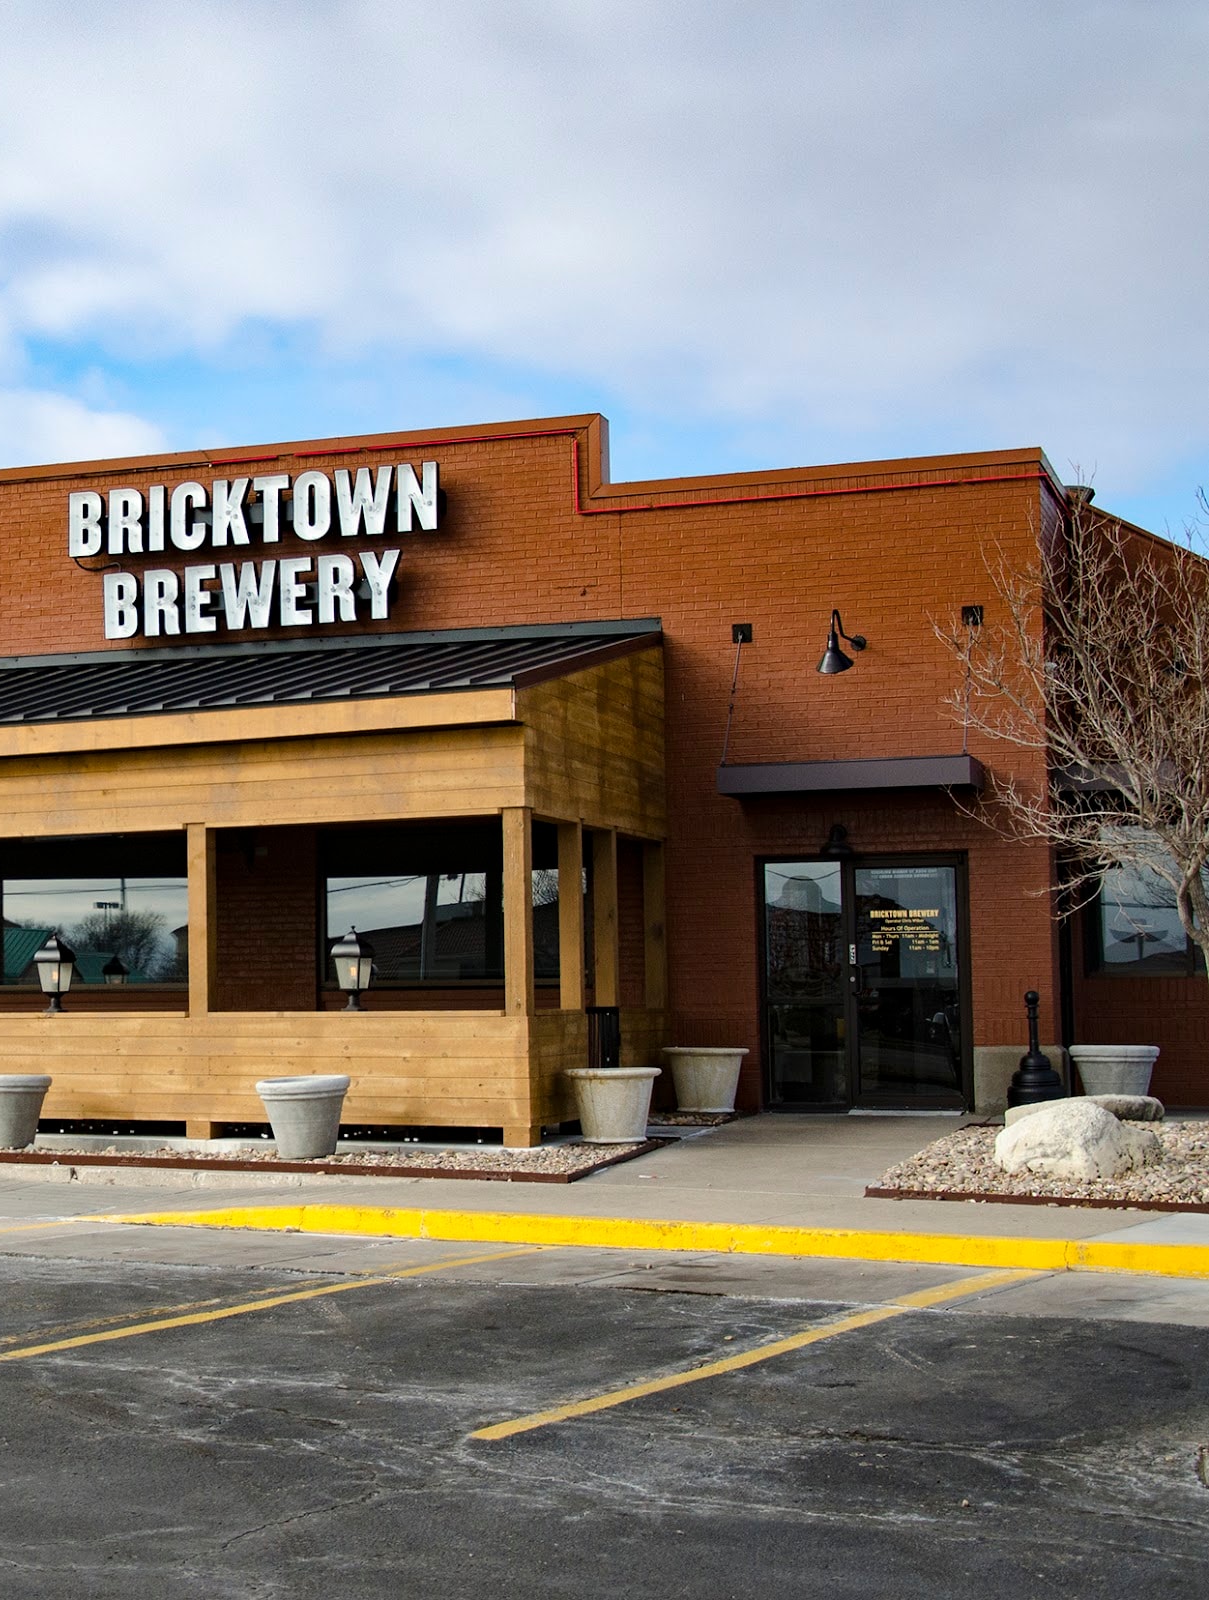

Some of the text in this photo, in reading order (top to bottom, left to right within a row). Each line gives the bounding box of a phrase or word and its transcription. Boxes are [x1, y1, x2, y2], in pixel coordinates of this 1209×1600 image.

[68, 461, 438, 558] BRICKTOWN
[103, 549, 401, 639] BREWERY
[870, 909, 939, 919] BRICKTOWN BREWERY
[904, 925, 929, 933] Operation
